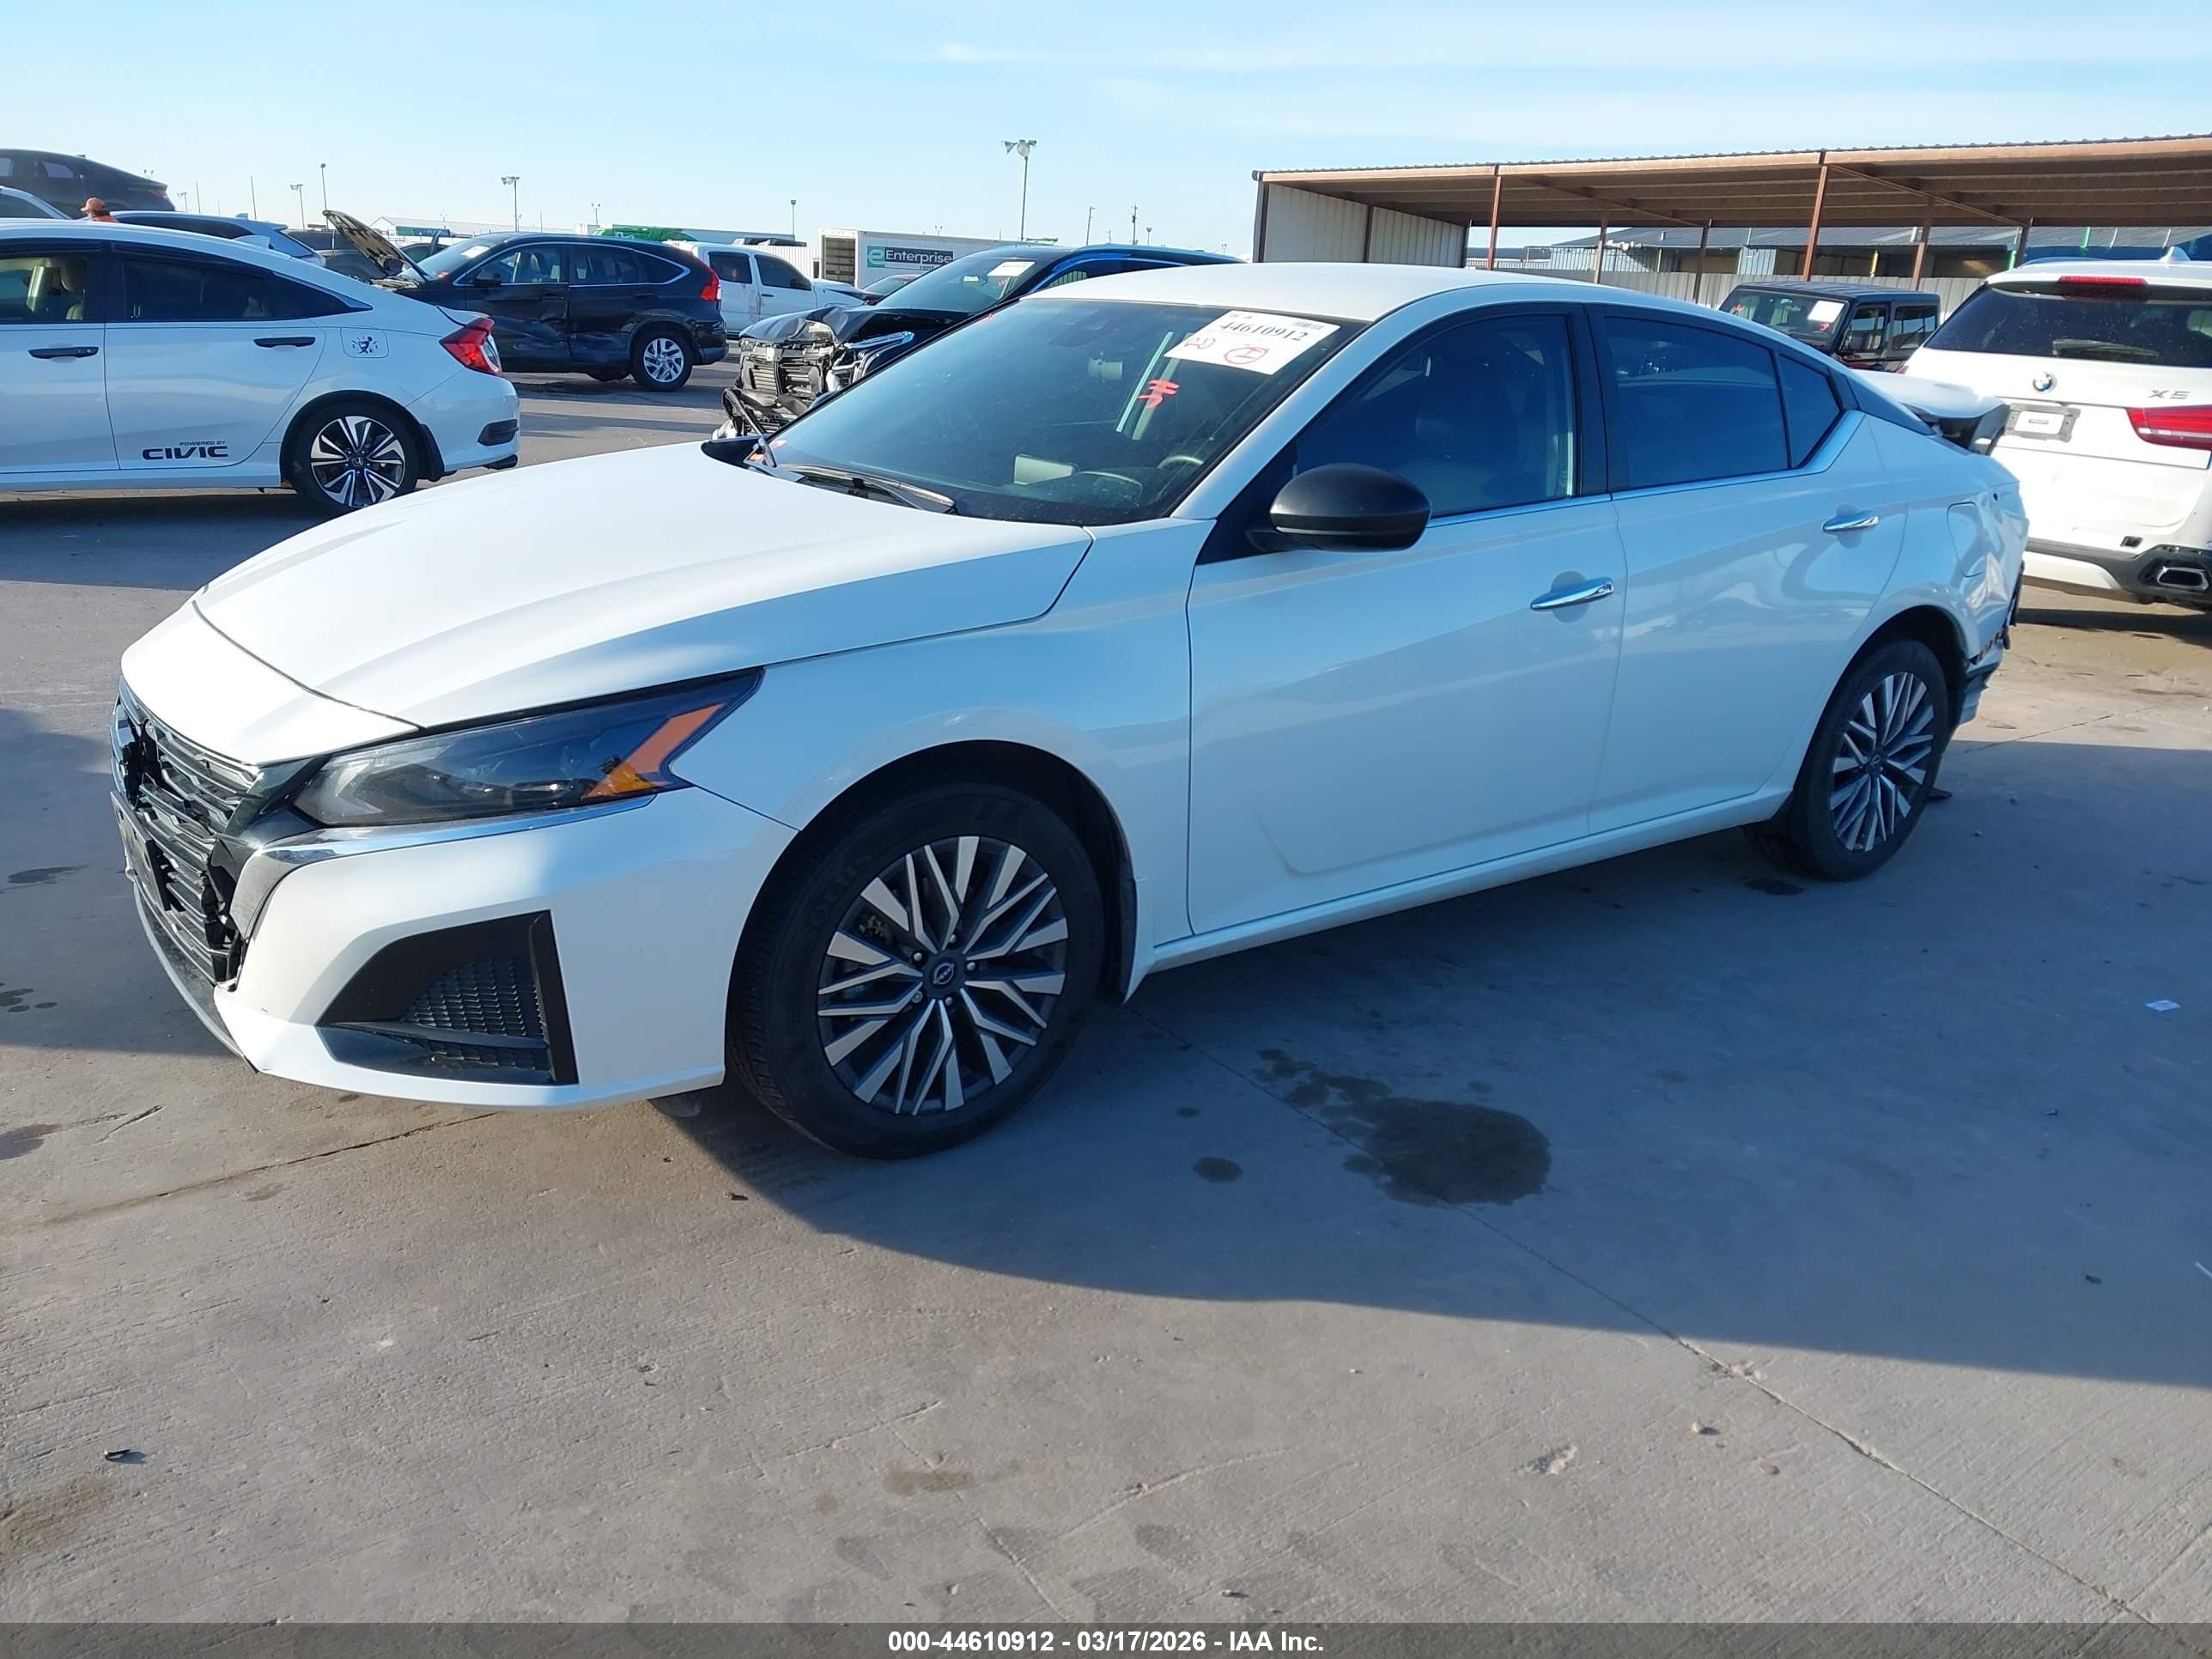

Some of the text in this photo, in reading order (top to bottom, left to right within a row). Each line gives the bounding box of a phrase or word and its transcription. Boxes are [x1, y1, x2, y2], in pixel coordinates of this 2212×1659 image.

[885, 250, 952, 264] Enterprise
[1219, 321, 1309, 341] 44610912
[2147, 390, 2191, 400] X5
[142, 446, 229, 460] CIVIC
